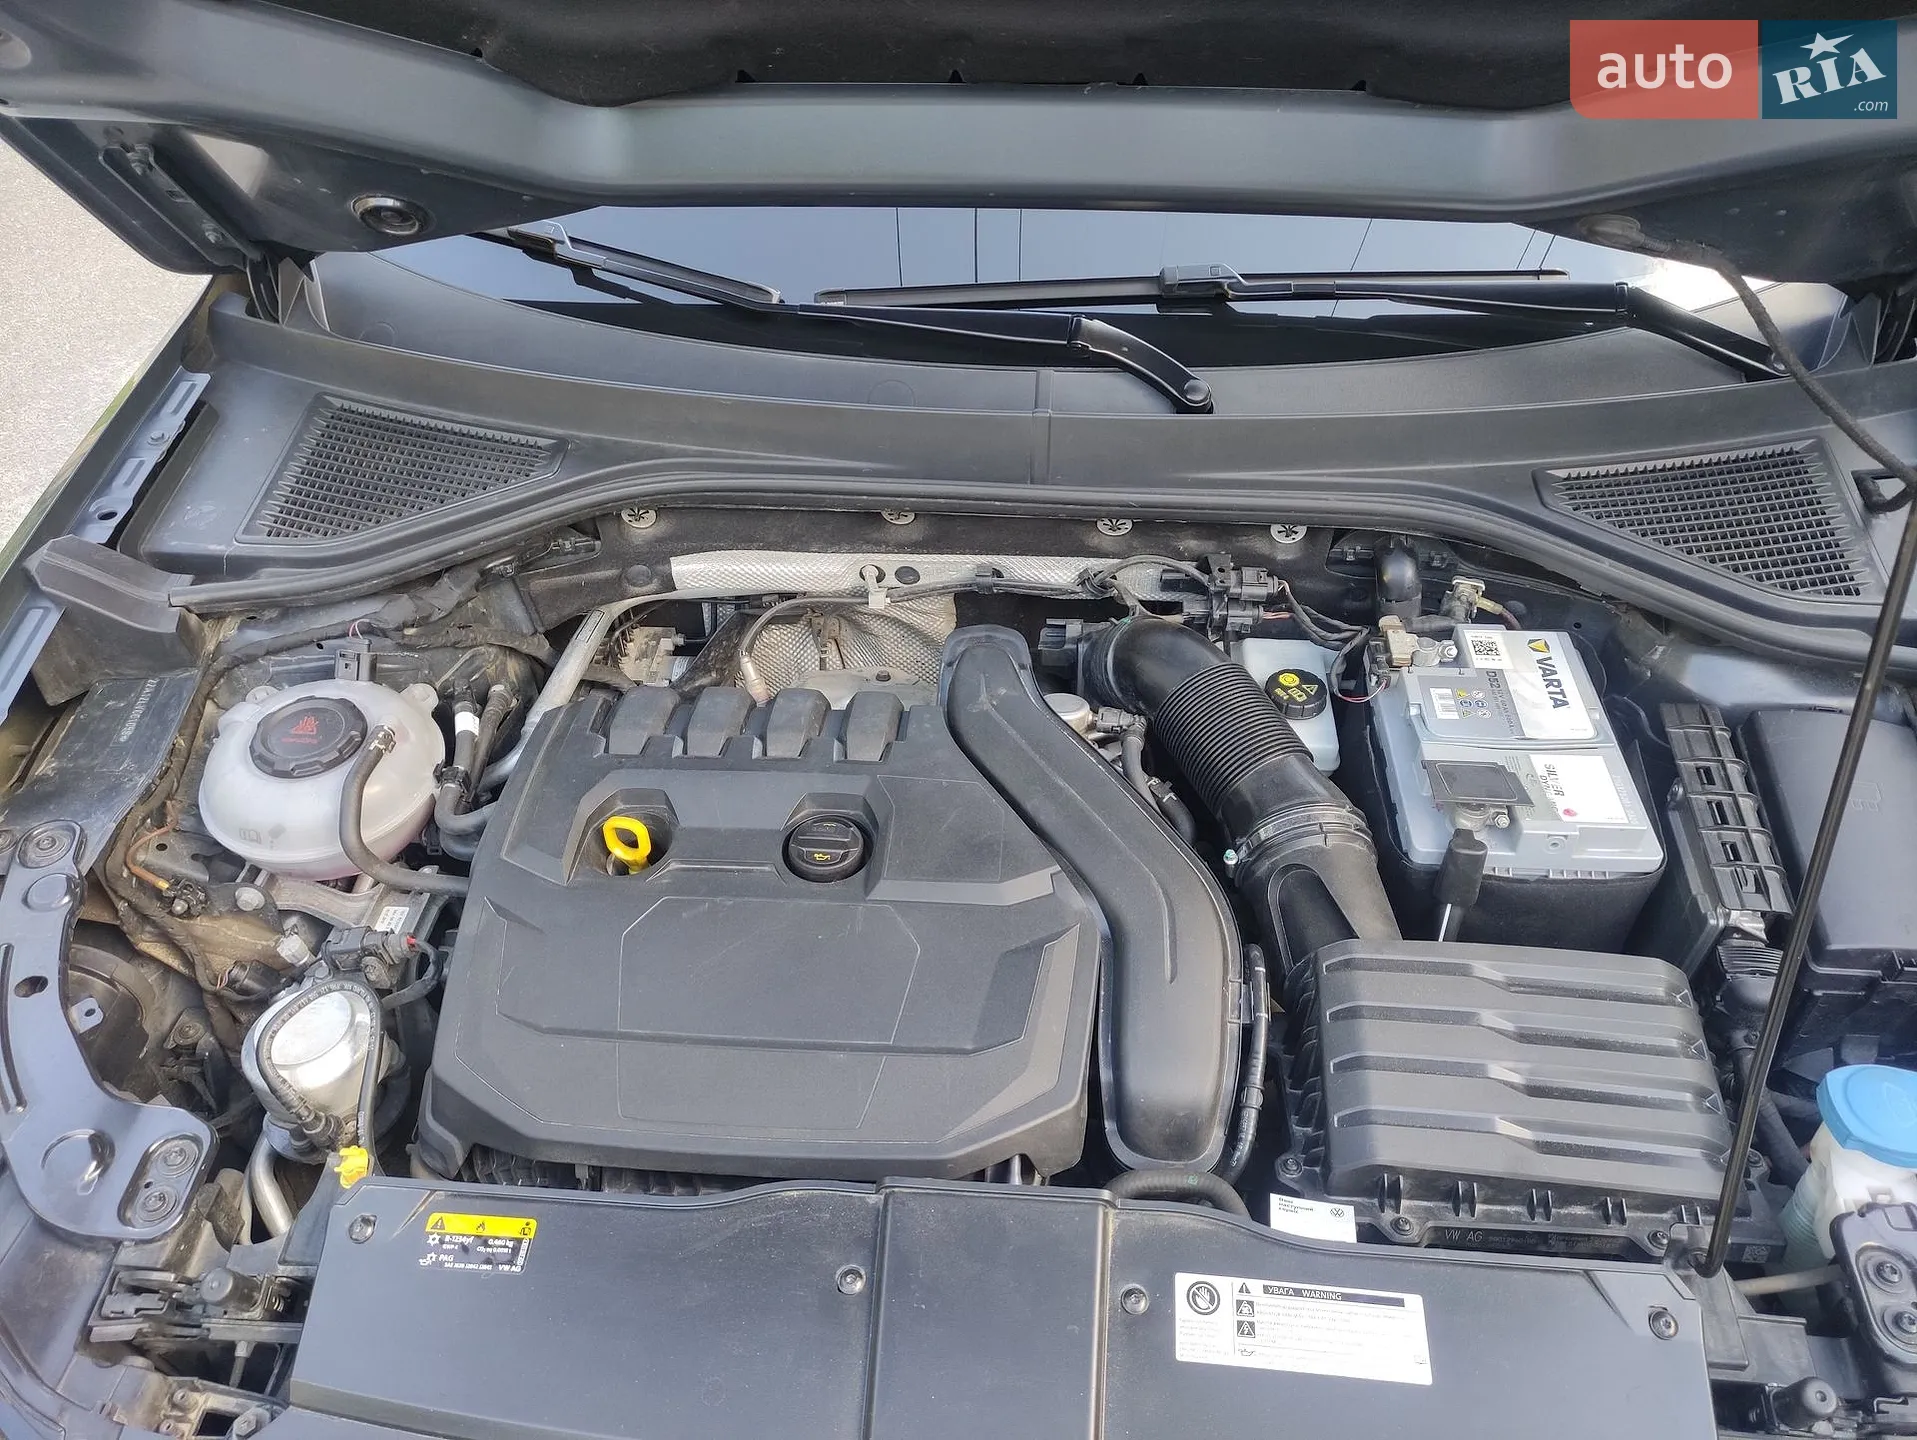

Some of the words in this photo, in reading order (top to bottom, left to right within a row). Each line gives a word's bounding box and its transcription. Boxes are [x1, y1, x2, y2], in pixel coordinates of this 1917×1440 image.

[1486, 671, 1500, 689] D52
[1534, 656, 1569, 709] VARTA
[1544, 763, 1564, 797] SILVER
[1445, 1229, 1461, 1241] VW
[1466, 1231, 1483, 1242] AG
[1267, 1286, 1295, 1296] УВАГА
[1302, 1289, 1342, 1300] WARNING
